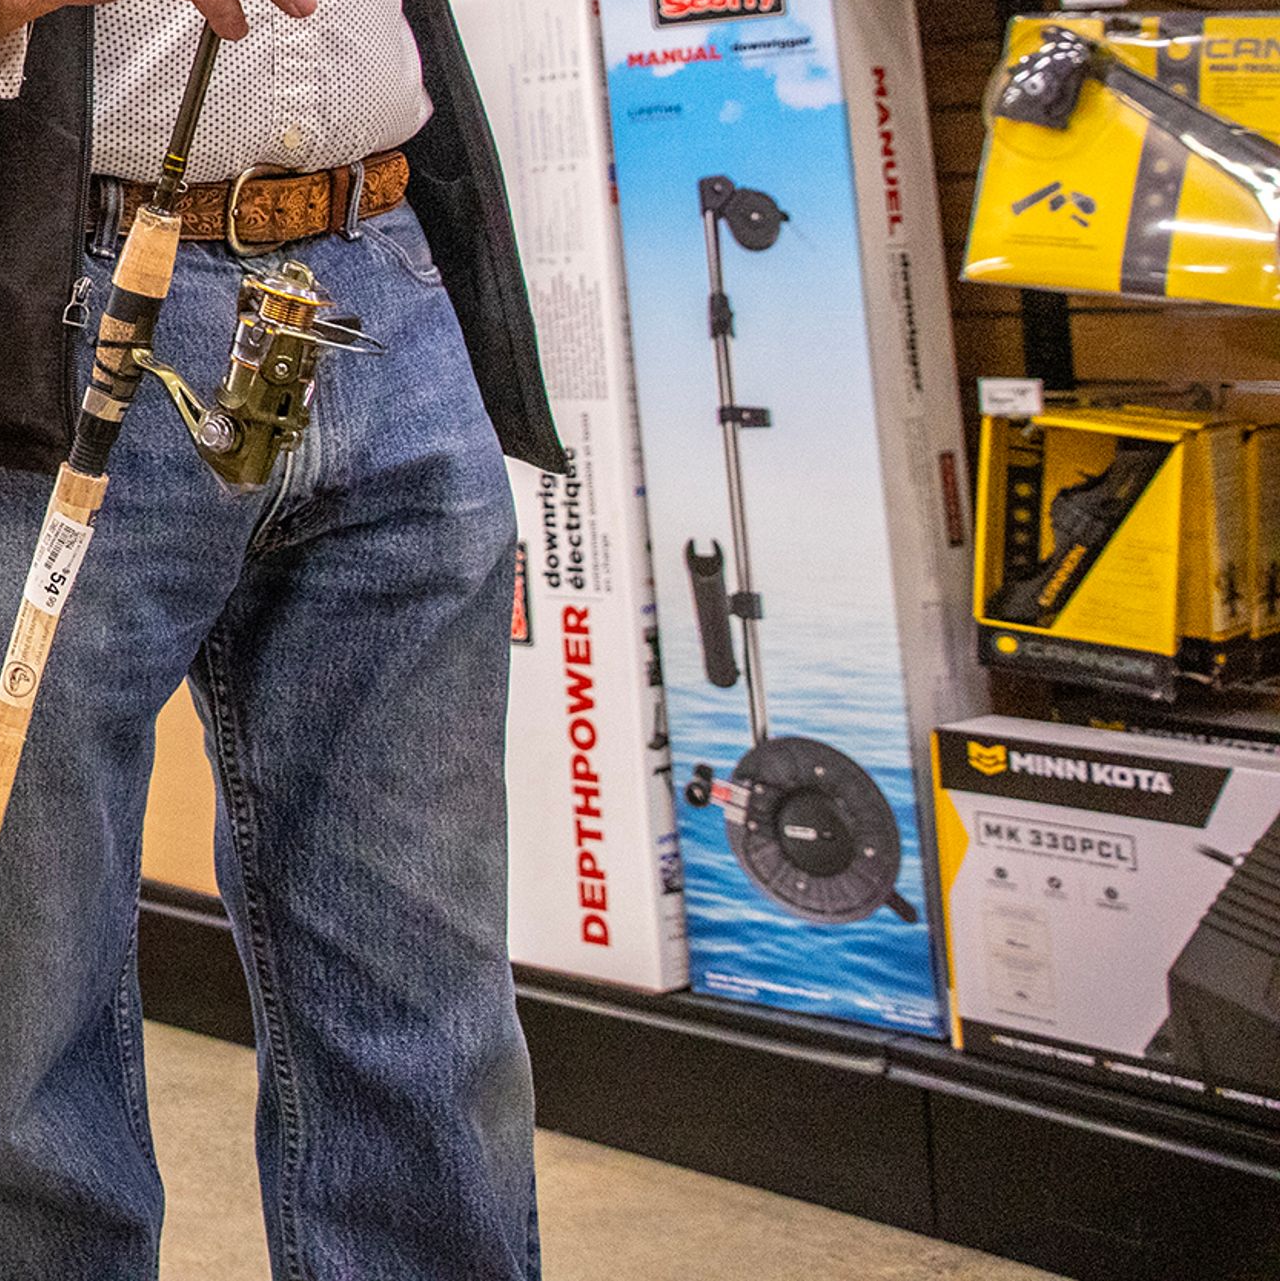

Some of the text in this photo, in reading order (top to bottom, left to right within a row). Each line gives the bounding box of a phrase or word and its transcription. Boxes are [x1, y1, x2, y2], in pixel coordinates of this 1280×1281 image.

[627, 45, 724, 68] MANUAL
[872, 66, 903, 236] MANUEL
[536, 472, 561, 588] downrig
[561, 604, 611, 948] DEPTHPOWER
[1009, 750, 1175, 795] MINN KOTA
[984, 823, 1131, 862] MK 330PCL
